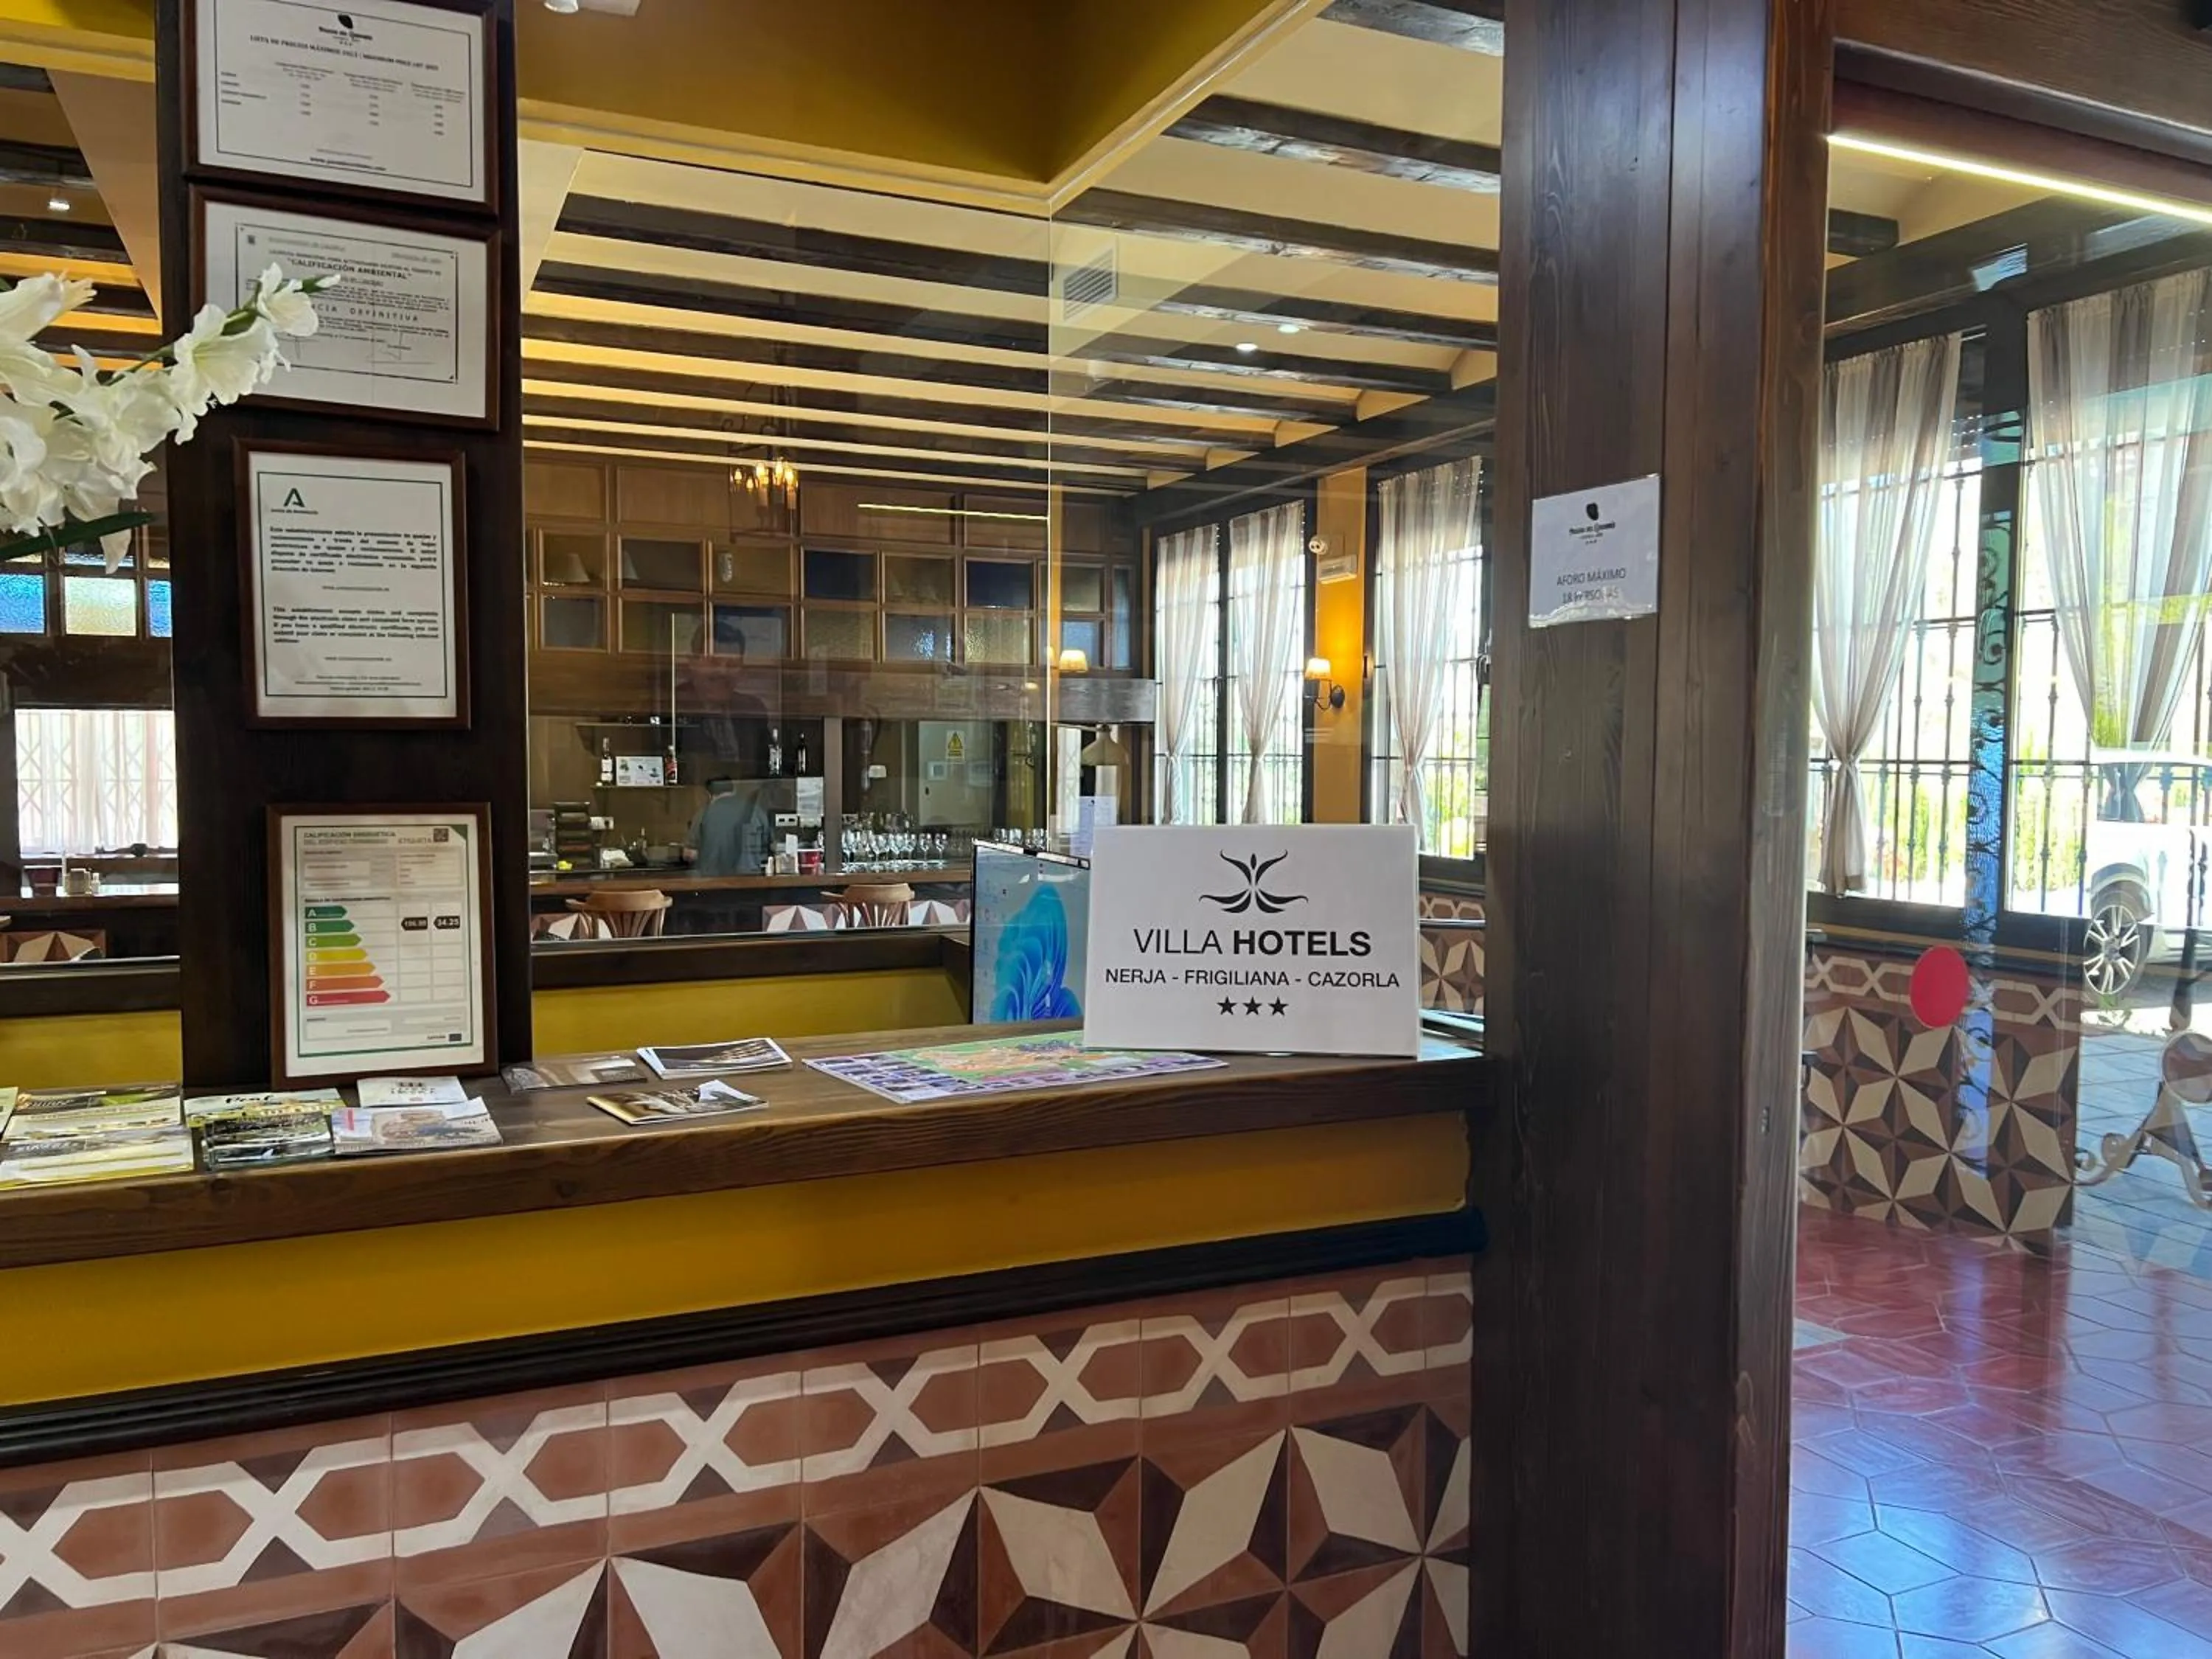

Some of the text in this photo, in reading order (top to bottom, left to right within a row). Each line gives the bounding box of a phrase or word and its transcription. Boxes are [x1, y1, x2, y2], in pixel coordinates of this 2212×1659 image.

[1557, 567, 1627, 586] AFORO MÁXIMO
[307, 908, 317, 917] A
[308, 922, 317, 932] B
[308, 937, 317, 946] C
[1133, 928, 1371, 957] VILLA HOTELS
[309, 952, 318, 961] D
[1105, 968, 1166, 984] NERJA
[1184, 970, 1290, 986] FRIGILIANA
[1307, 971, 1400, 988] CAZORLA
[309, 995, 318, 1005] G
